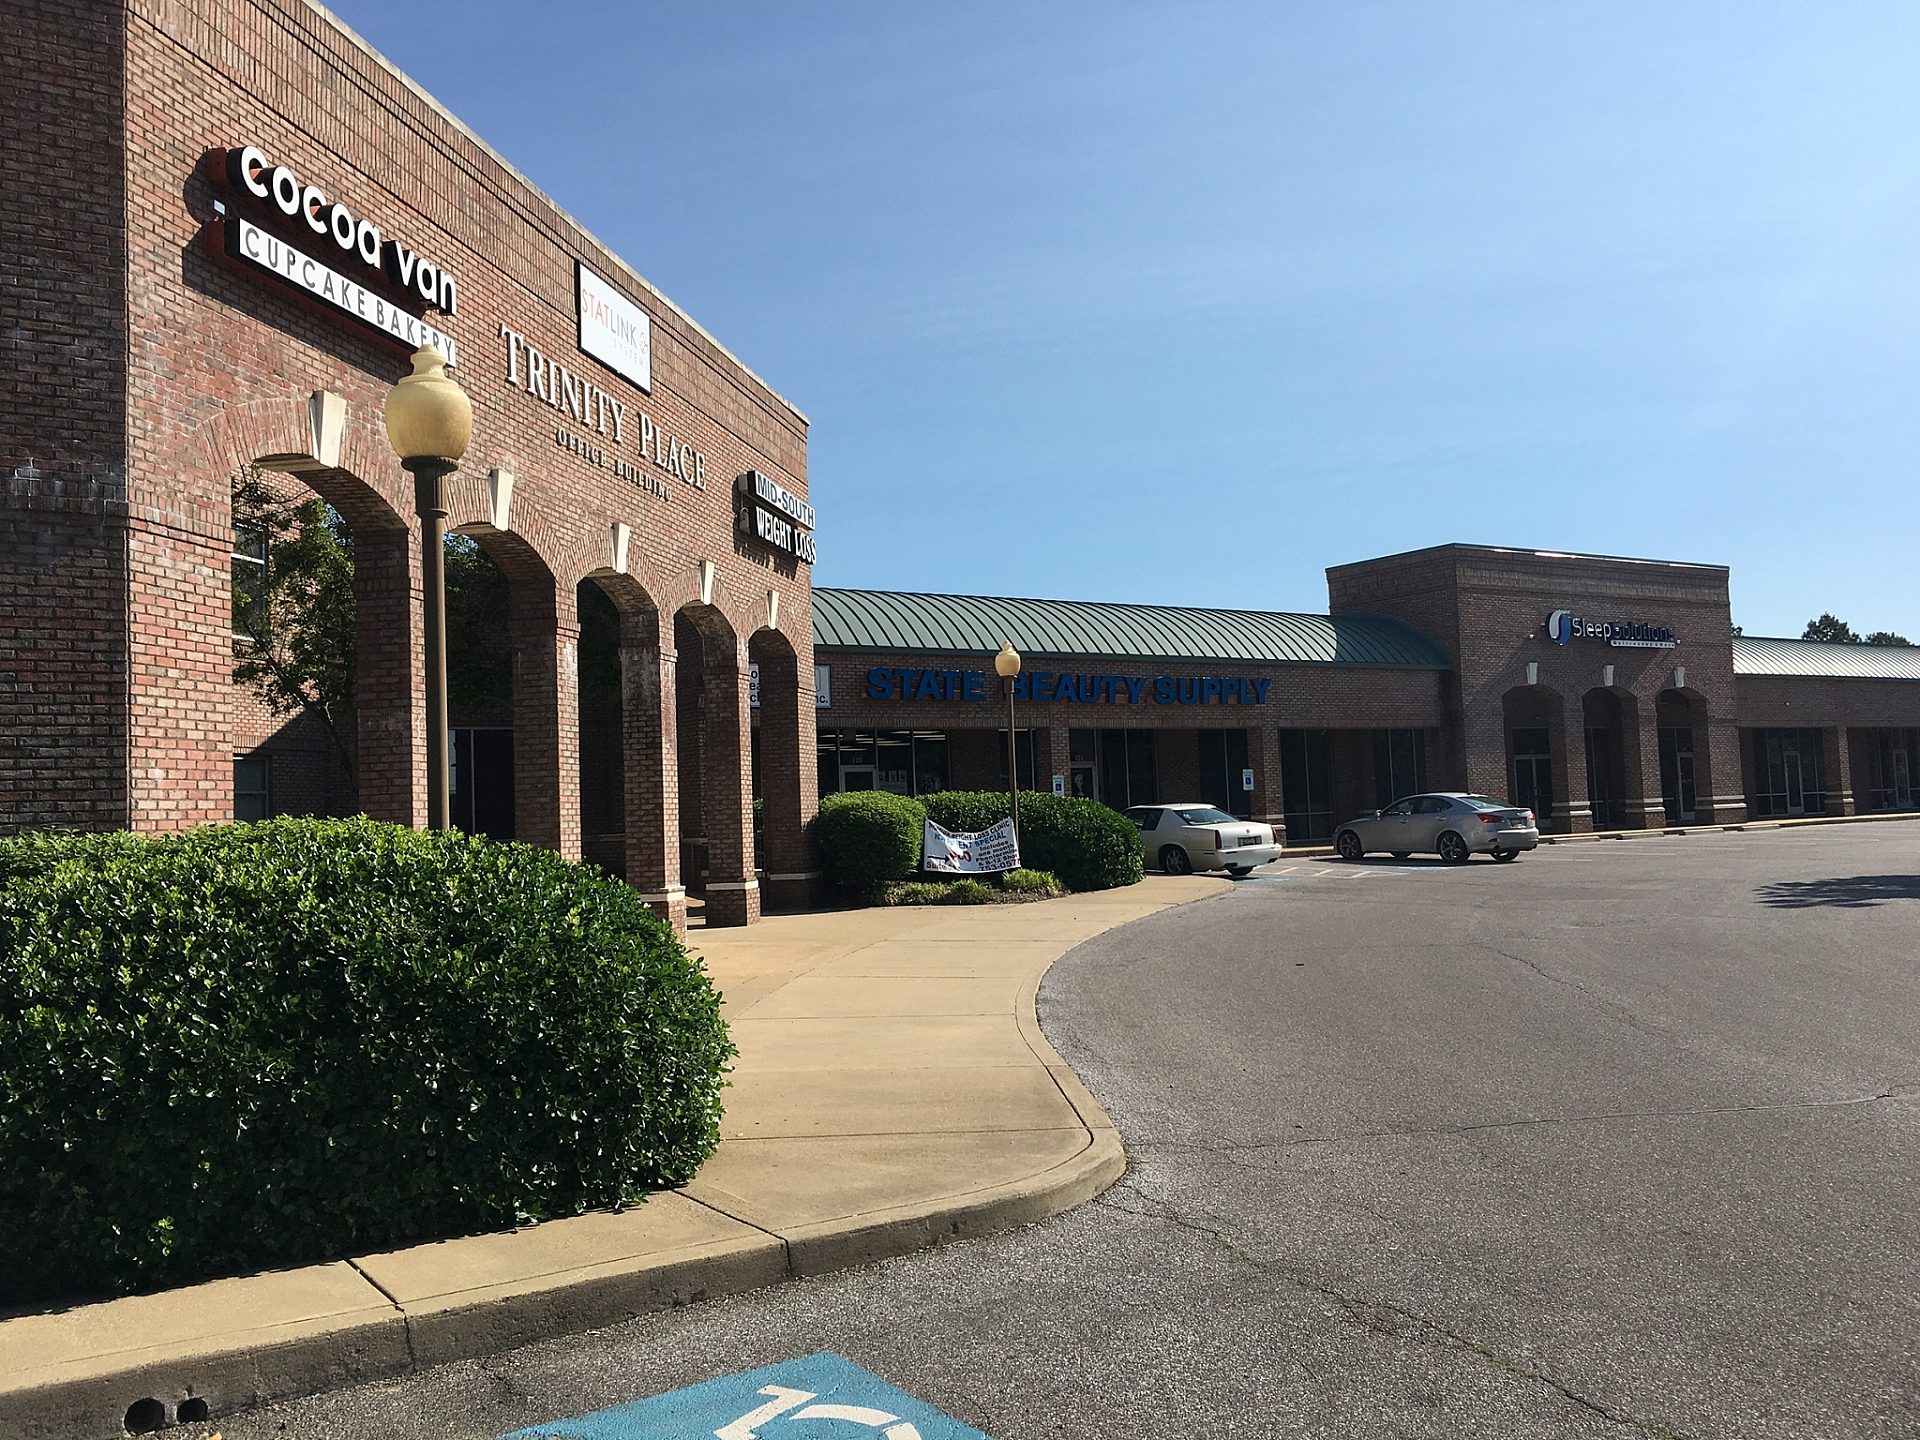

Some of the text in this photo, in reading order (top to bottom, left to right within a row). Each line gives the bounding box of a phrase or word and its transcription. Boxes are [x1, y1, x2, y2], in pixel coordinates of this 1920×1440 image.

[240, 145, 457, 316] cocoa van
[245, 228, 365, 316] CUPCAKE
[582, 288, 637, 349] STATLINK
[500, 323, 707, 491] TRINITY PLACE
[557, 428, 673, 501] OFFICE BUILDING
[757, 474, 815, 527] MID-SOUTH
[756, 506, 817, 565] WEIGHT LOSS
[1572, 618, 1612, 641] Sleep
[866, 667, 1272, 705] STATE BEAUTY SUPPLY
[974, 830, 989, 840] LOSS
[990, 821, 1009, 834] CLINIC
[975, 831, 1006, 846] SPECIAL
